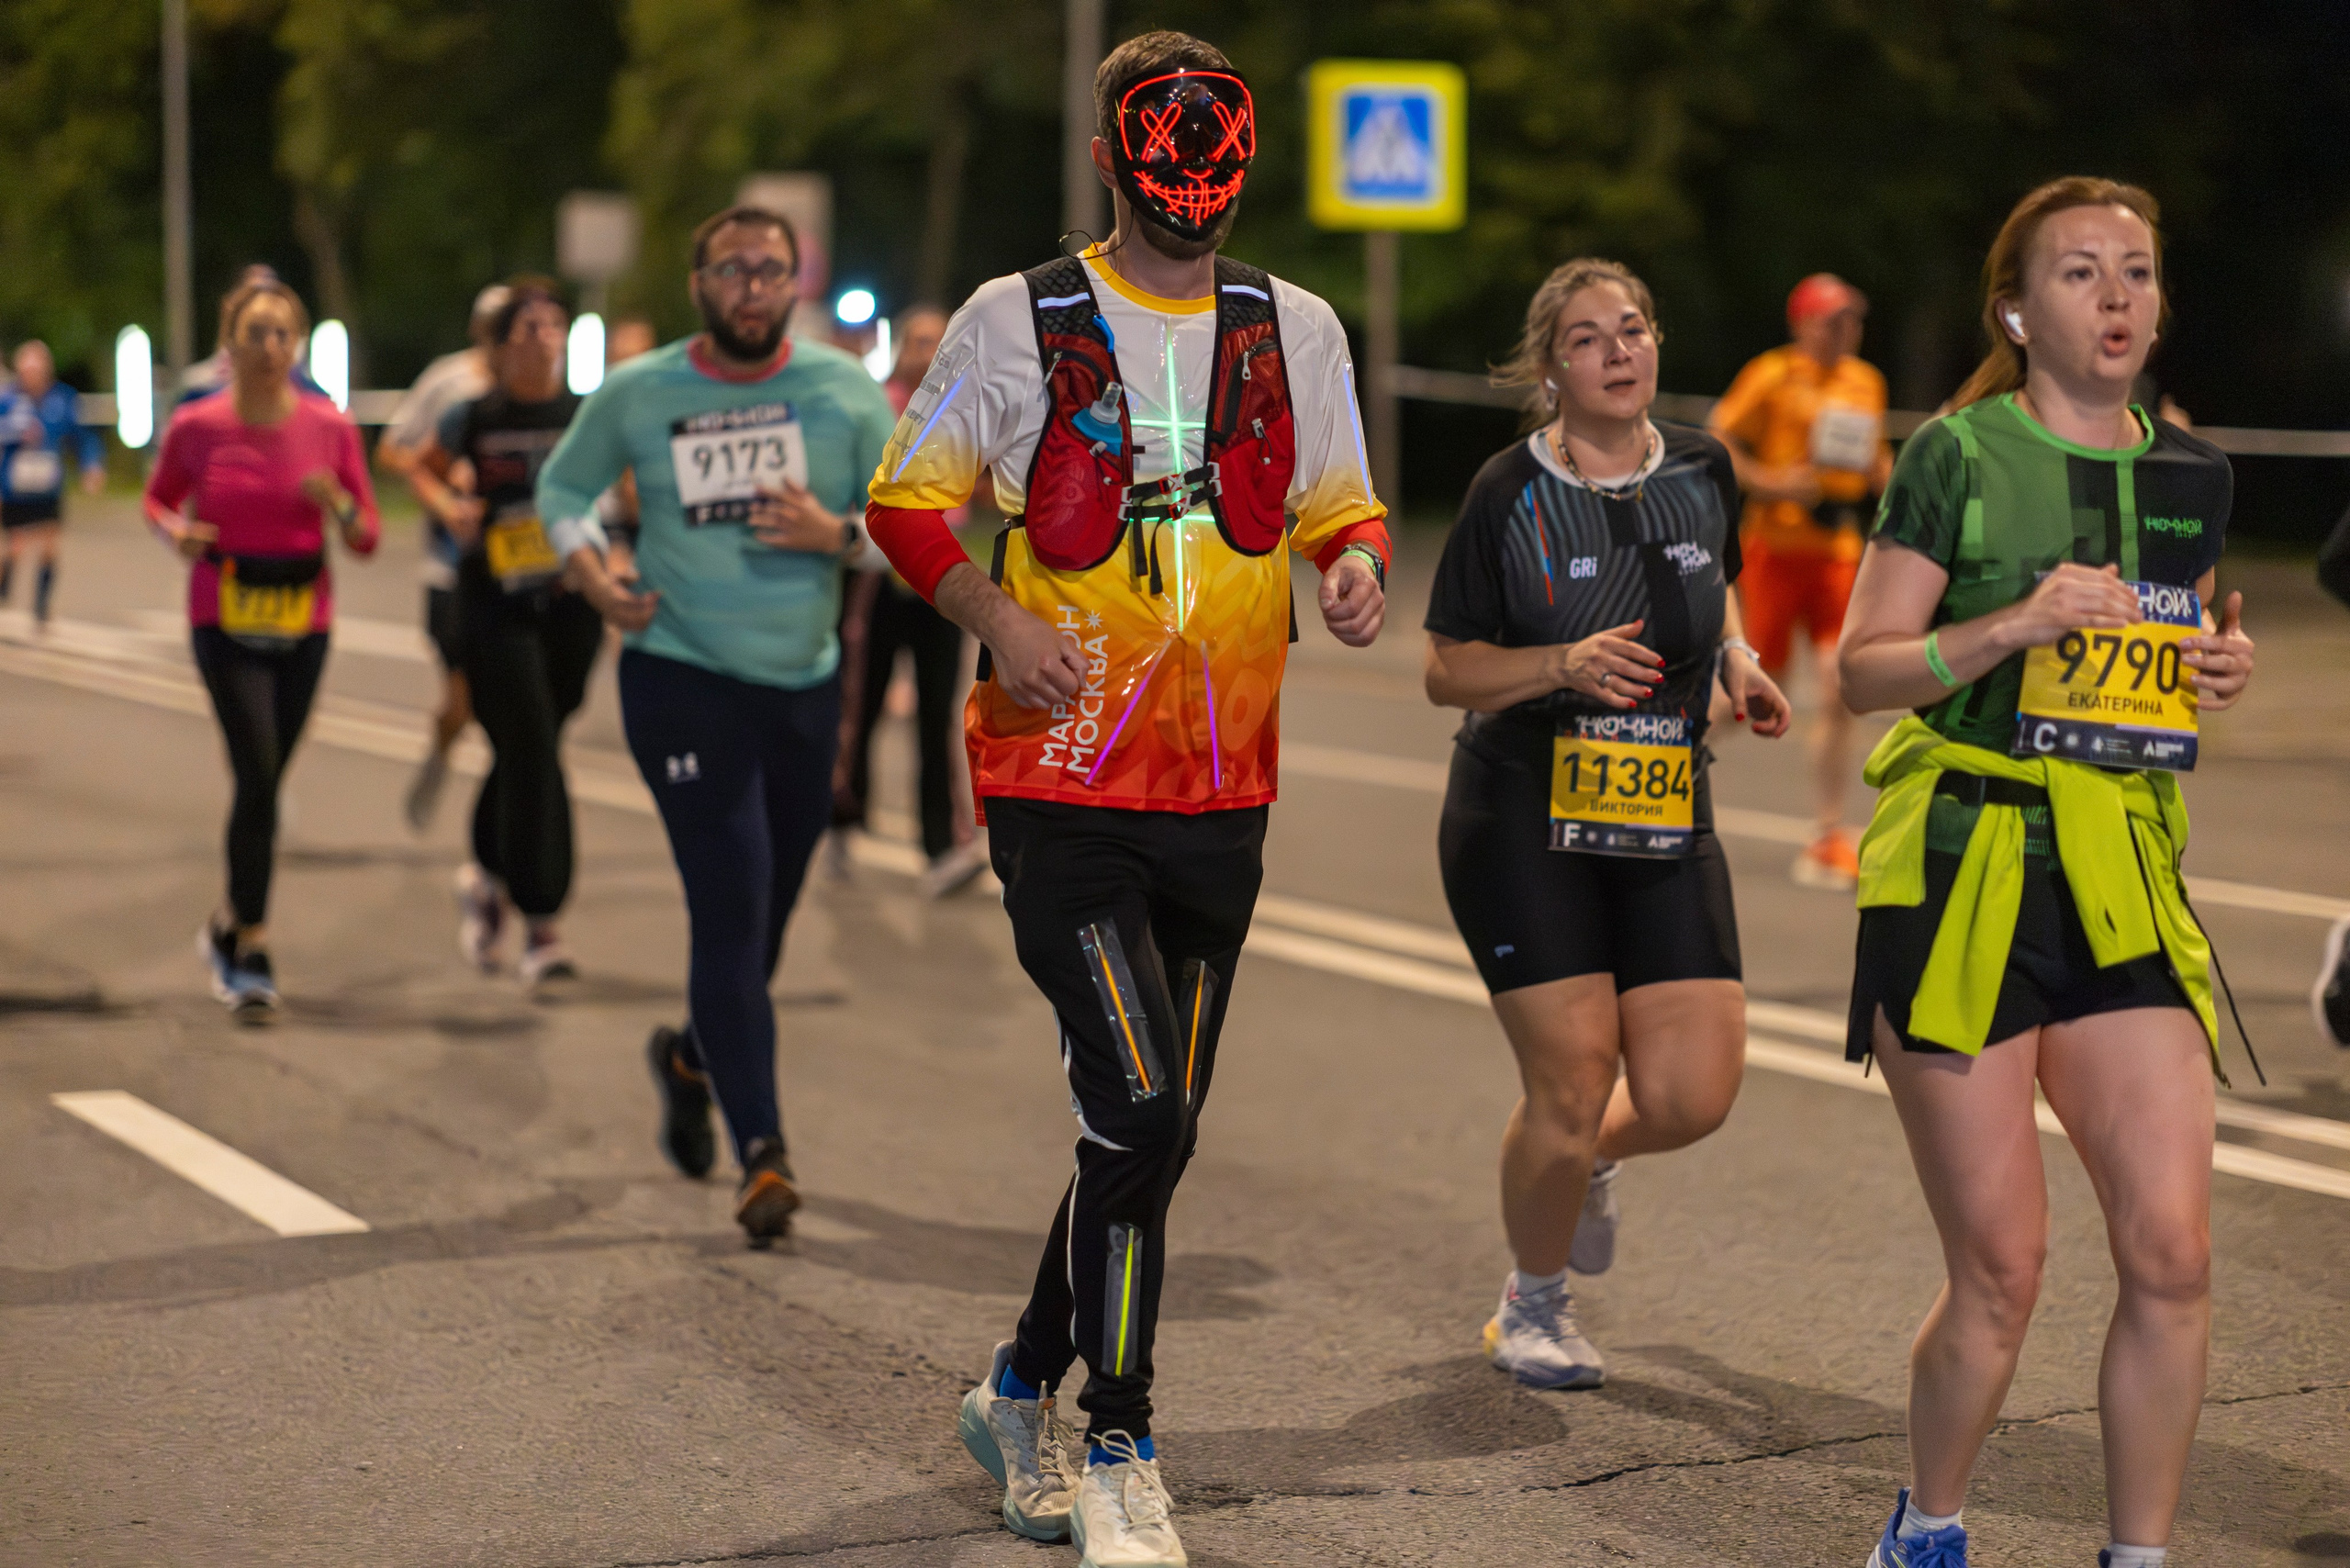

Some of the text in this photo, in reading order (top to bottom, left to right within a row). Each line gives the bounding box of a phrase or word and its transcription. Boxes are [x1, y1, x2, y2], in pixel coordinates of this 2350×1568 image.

[693, 434, 788, 480] 9173
[1570, 556, 1597, 578] GRi
[2057, 631, 2181, 695] 9790
[1066, 633, 1109, 773] МОСКВА
[2067, 692, 2164, 716] ЕКАТЕРИНА
[1562, 752, 1690, 801] 11384
[1563, 823, 1582, 847] F
